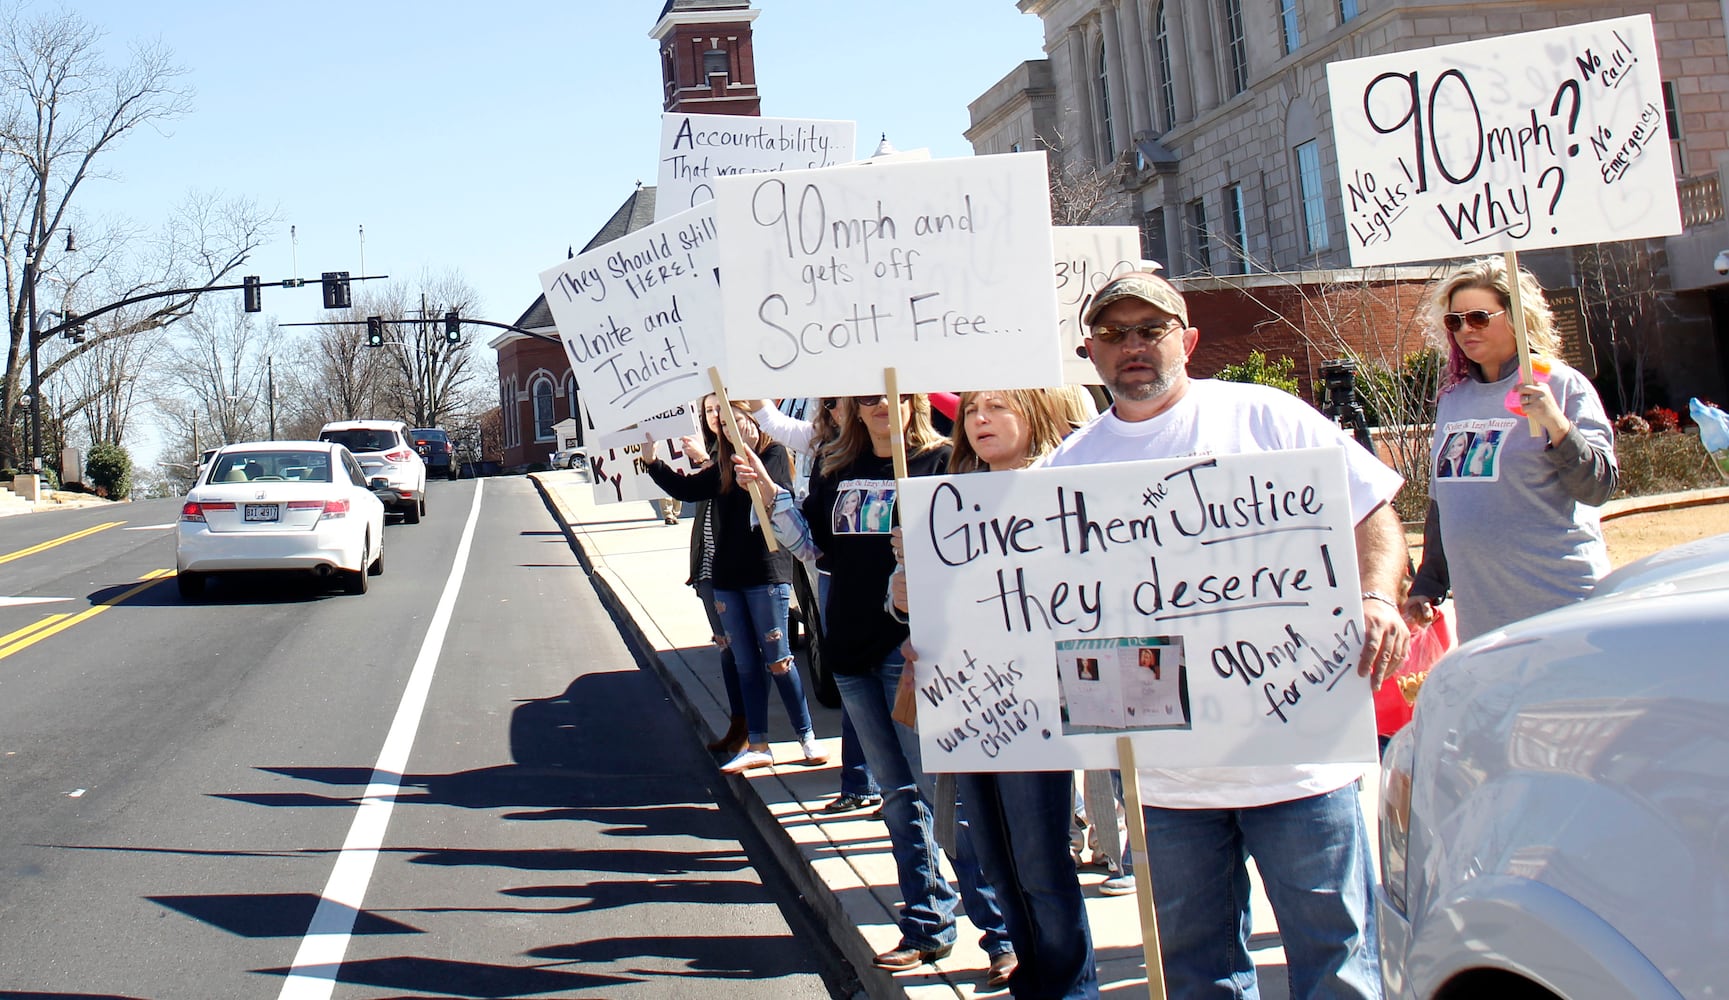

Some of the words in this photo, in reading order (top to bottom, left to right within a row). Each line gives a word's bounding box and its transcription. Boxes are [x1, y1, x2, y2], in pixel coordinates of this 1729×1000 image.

[1576, 48, 1602, 81] No
[663, 154, 709, 182] That
[1590, 125, 1613, 160] No
[915, 195, 975, 236] and
[551, 268, 606, 302] They
[802, 250, 853, 305] gets
[875, 248, 920, 281] off
[567, 315, 633, 364] Unite
[644, 295, 682, 332] and
[758, 293, 894, 370] Scott
[593, 326, 699, 404] Indict!
[929, 482, 1044, 566] Give
[1045, 486, 1163, 554] them
[1163, 459, 1324, 538] Justice
[1143, 482, 1169, 509] the
[976, 568, 1102, 632] they
[1133, 544, 1344, 618] deserve!
[957, 686, 981, 713] if
[983, 660, 1023, 696] this
[1264, 679, 1302, 723] for
[937, 718, 981, 753] was
[981, 687, 1018, 734] your
